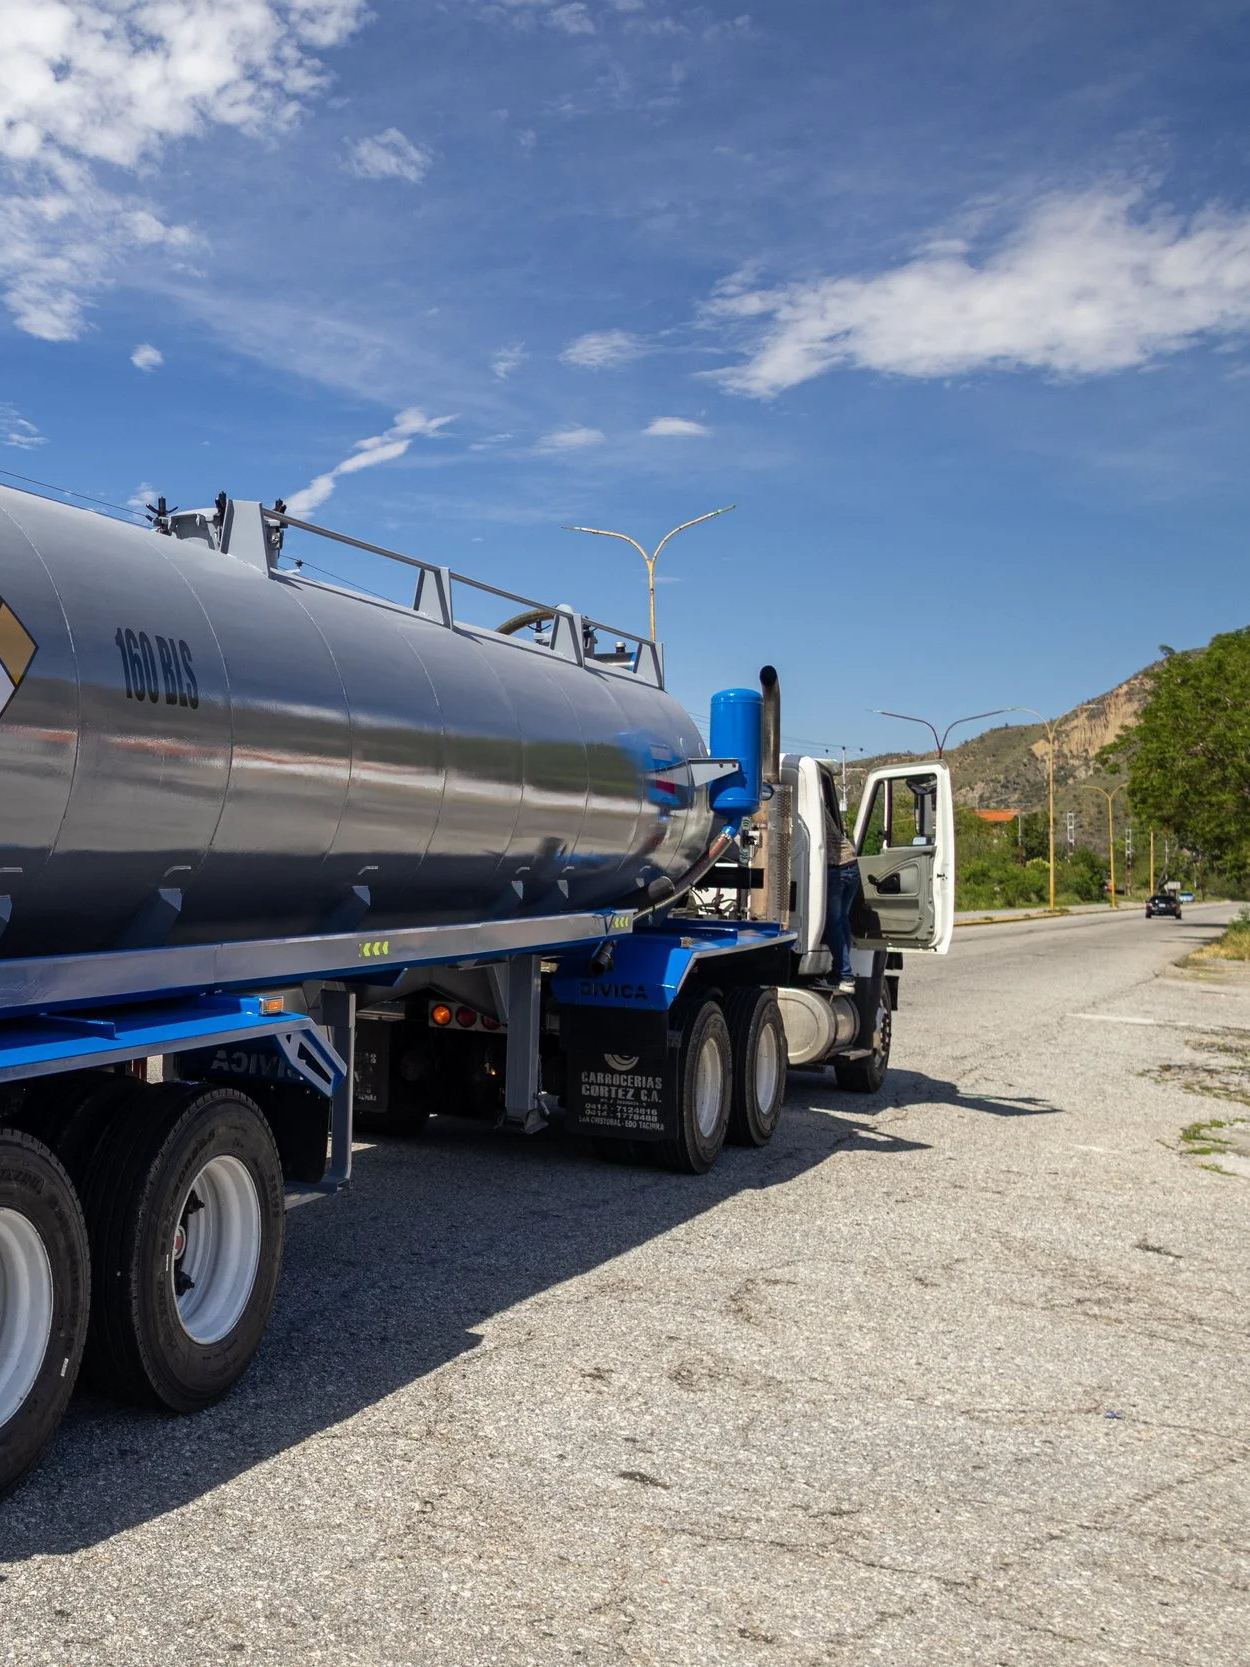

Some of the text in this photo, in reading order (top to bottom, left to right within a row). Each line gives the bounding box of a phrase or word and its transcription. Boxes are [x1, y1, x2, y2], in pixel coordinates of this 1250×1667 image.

[115, 627, 159, 704] 160
[579, 982, 648, 1000] DIVICA
[581, 1071, 663, 1089] CARROCERIAS
[581, 1084, 635, 1100] CORTEZ
[640, 1090, 662, 1103] C.A.
